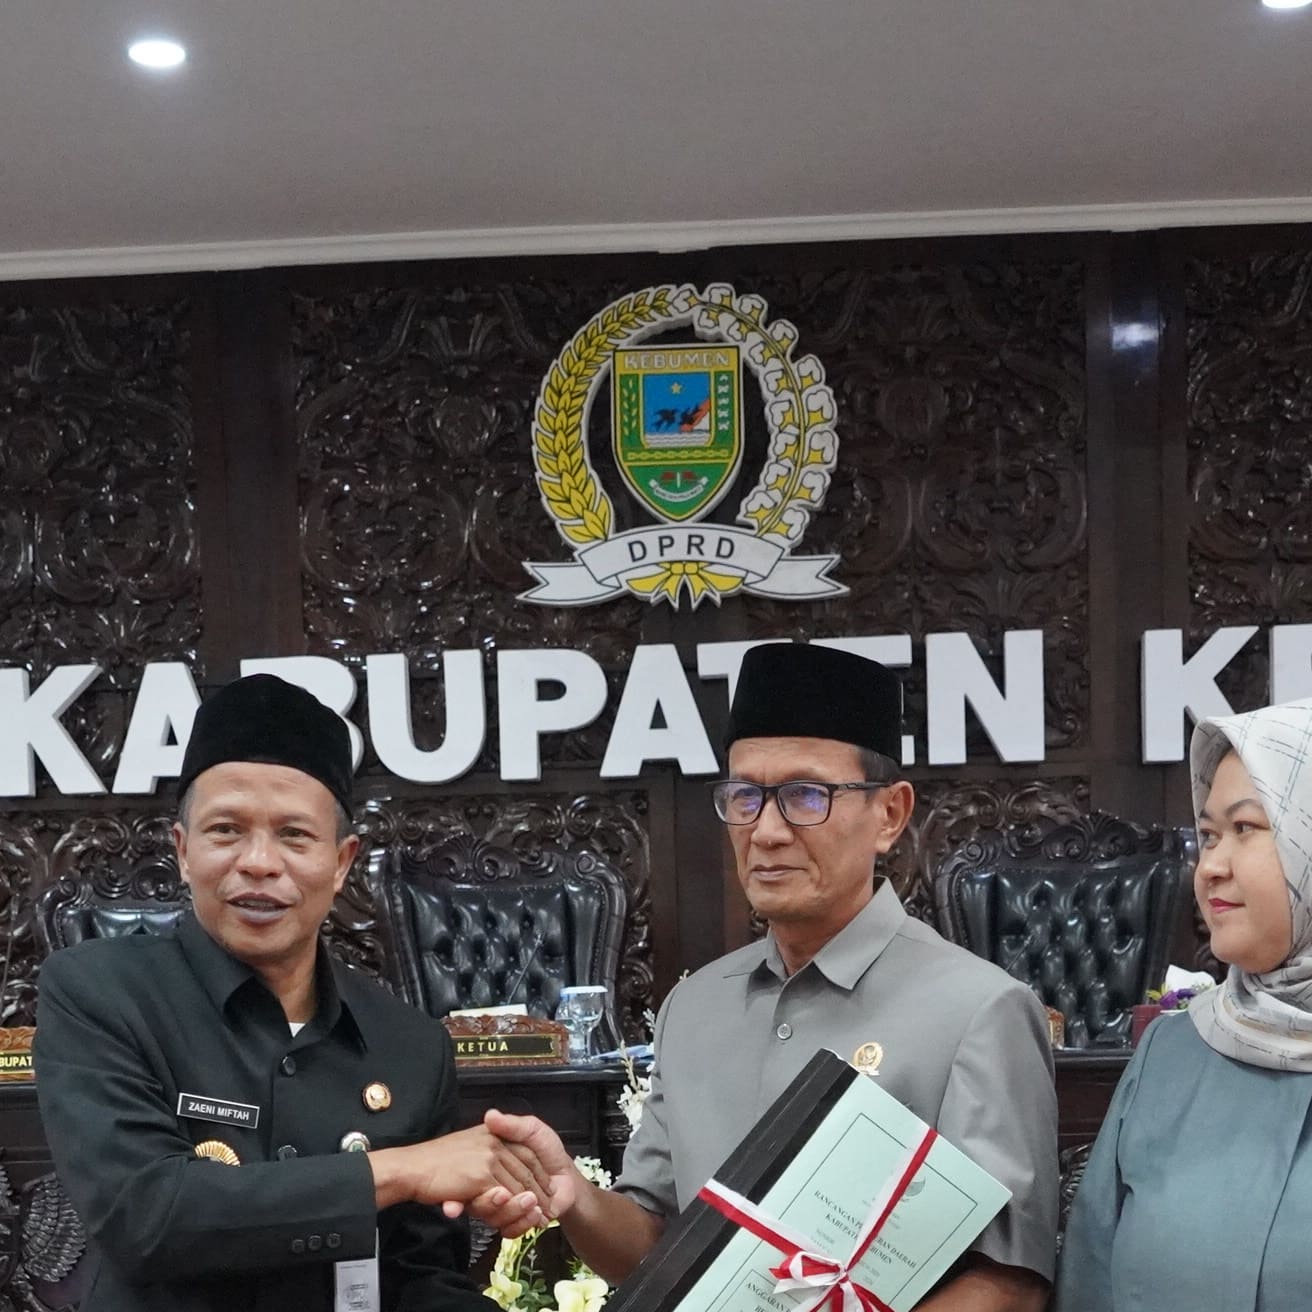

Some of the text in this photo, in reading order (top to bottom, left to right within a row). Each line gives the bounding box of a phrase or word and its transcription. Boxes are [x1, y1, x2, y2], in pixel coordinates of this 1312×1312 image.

[624, 352, 730, 369] KEBUMEN
[628, 534, 735, 562] DPRD
[457, 1041, 509, 1052] KETUA
[188, 1102, 249, 1120] ZAENI MIFTAH
[813, 1189, 858, 1225] RANCANGAN
